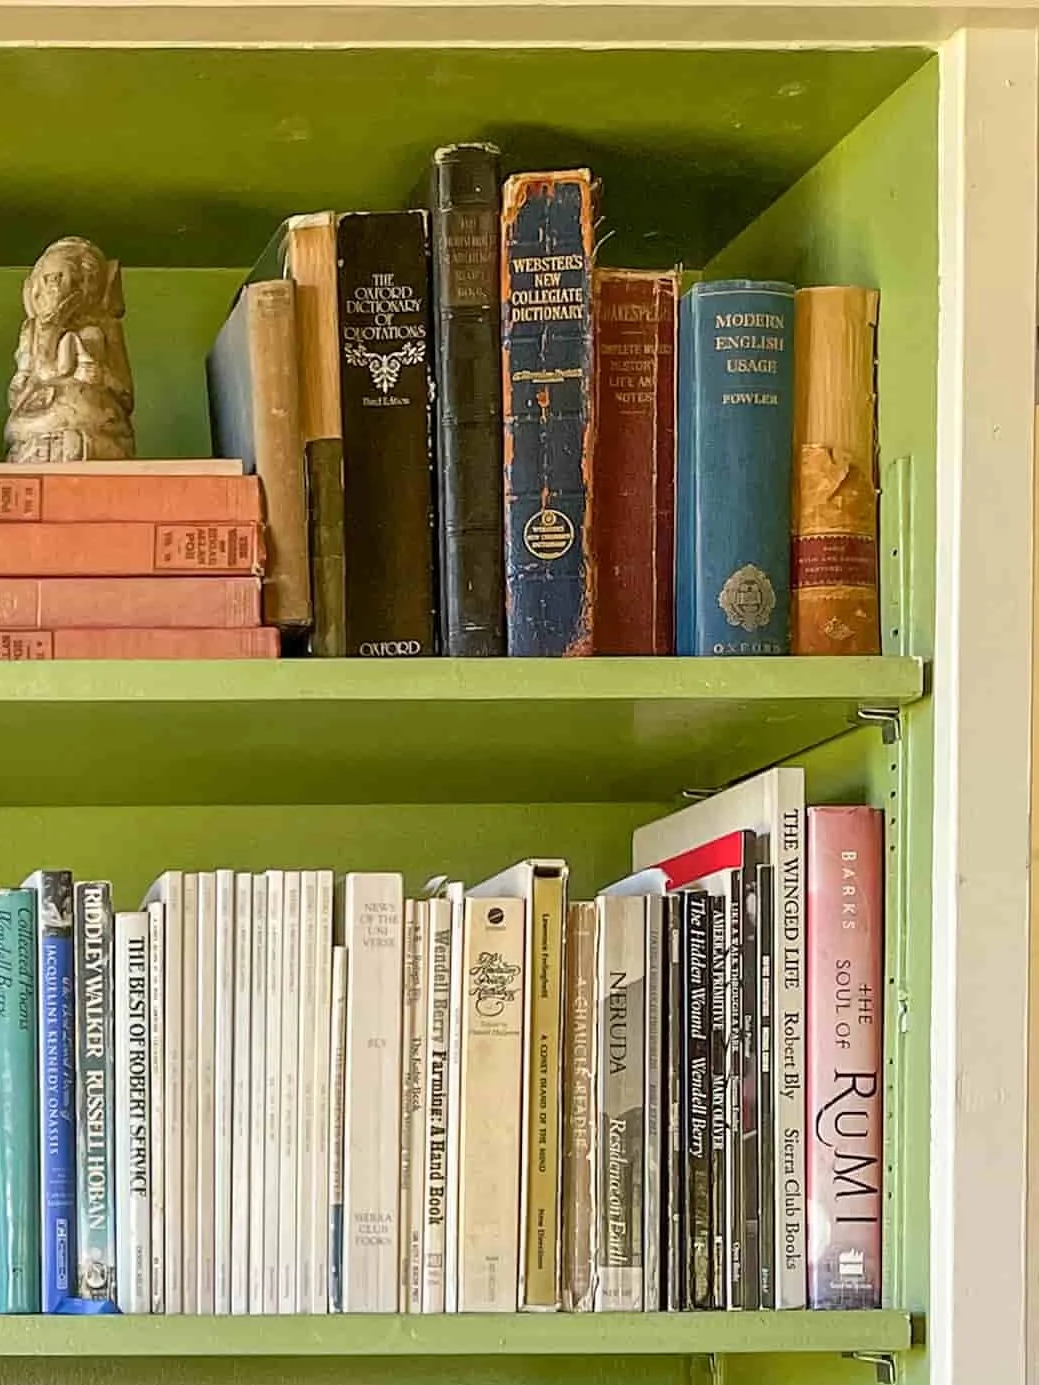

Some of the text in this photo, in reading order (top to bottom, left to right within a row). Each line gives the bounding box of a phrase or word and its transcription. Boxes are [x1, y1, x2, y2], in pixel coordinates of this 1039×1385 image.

[512, 254, 583, 273] WEBSTER'S
[372, 273, 395, 287] THE
[534, 273, 561, 287] NEW
[354, 287, 413, 300] OXFORD
[512, 288, 583, 305] COLLEGIATE
[346, 300, 423, 313] DICTIONARY
[512, 304, 584, 322] DICTIONARY
[374, 313, 394, 326] OF
[715, 313, 785, 329] MODERN
[344, 325, 426, 342] QUOTATIONS
[715, 336, 784, 351] ENGLISH
[726, 359, 778, 373] USAGE
[722, 393, 779, 405] FOWLER
[359, 641, 421, 656] OXFORD
[841, 850, 858, 931] BARKS
[17, 907, 35, 1030] Collected Poems
[835, 959, 852, 1014] SOUL
[688, 898, 706, 1158] The Hidden Wound Wendell Berry
[780, 808, 800, 1270] THE WINGED LIFE Robert Bly Sierra Club Books
[85, 887, 105, 1229] RIDDLEY WALKER RUSSELL HOBAN
[127, 936, 146, 1197] THE BEST OF ROBERT SERVICE
[608, 972, 627, 1264] NERUDA Residence on Earth
[429, 1051, 447, 1225] Farming: A Hand Book
